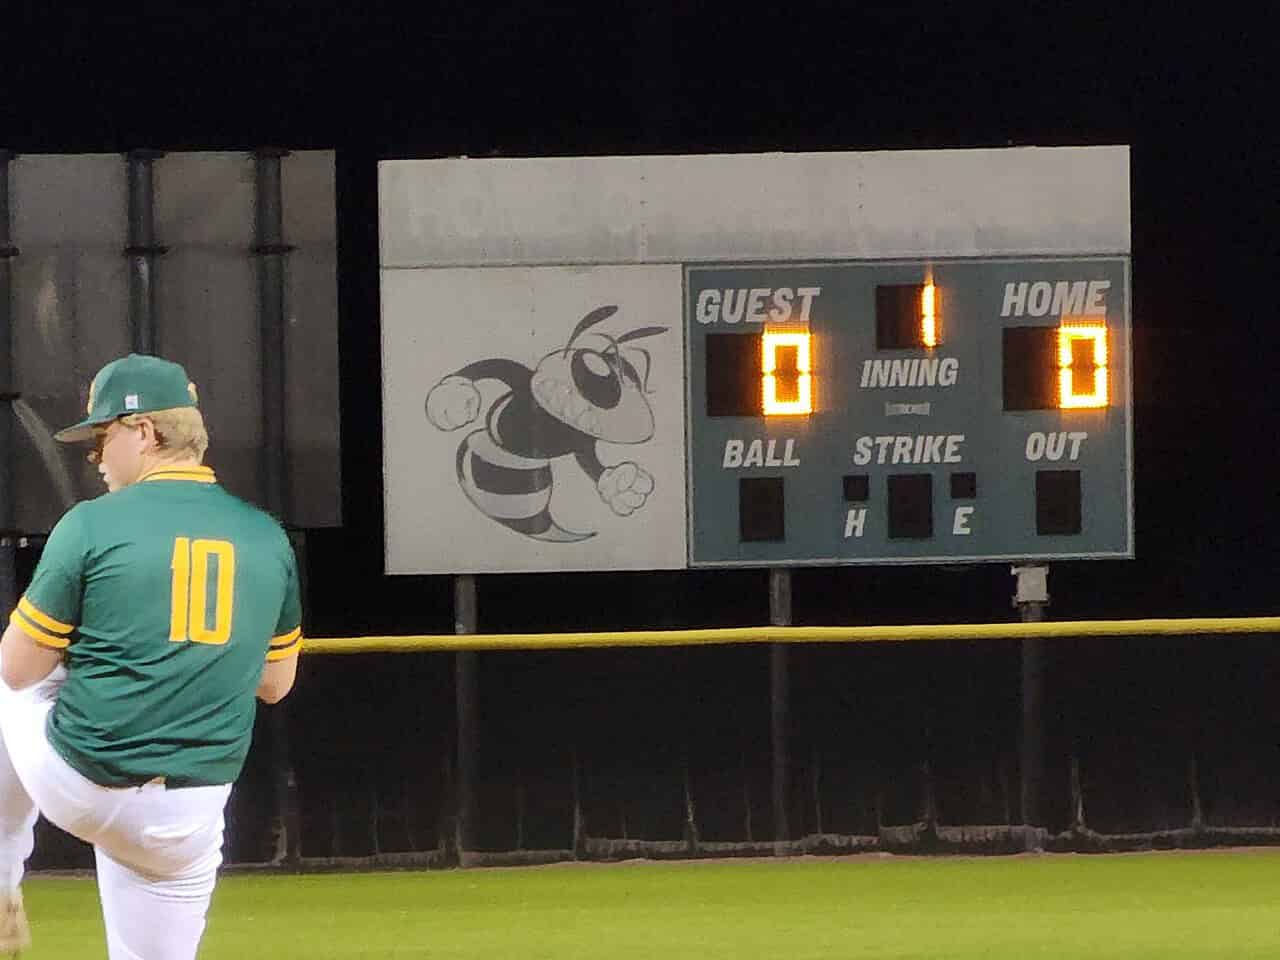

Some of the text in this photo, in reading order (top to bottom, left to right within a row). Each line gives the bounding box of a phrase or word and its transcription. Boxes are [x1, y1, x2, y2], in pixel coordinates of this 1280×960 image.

[696, 287, 820, 324] GUEST
[921, 283, 936, 347] 1
[1000, 280, 1111, 317] HOME
[762, 332, 811, 415] 0
[859, 358, 959, 388] INNING
[1058, 326, 1108, 408] 0
[723, 439, 801, 468] BALL
[853, 434, 965, 465] STRIKE
[1025, 432, 1088, 461] OUT
[844, 508, 867, 538] H
[952, 506, 974, 535] E
[169, 536, 236, 645] 10
